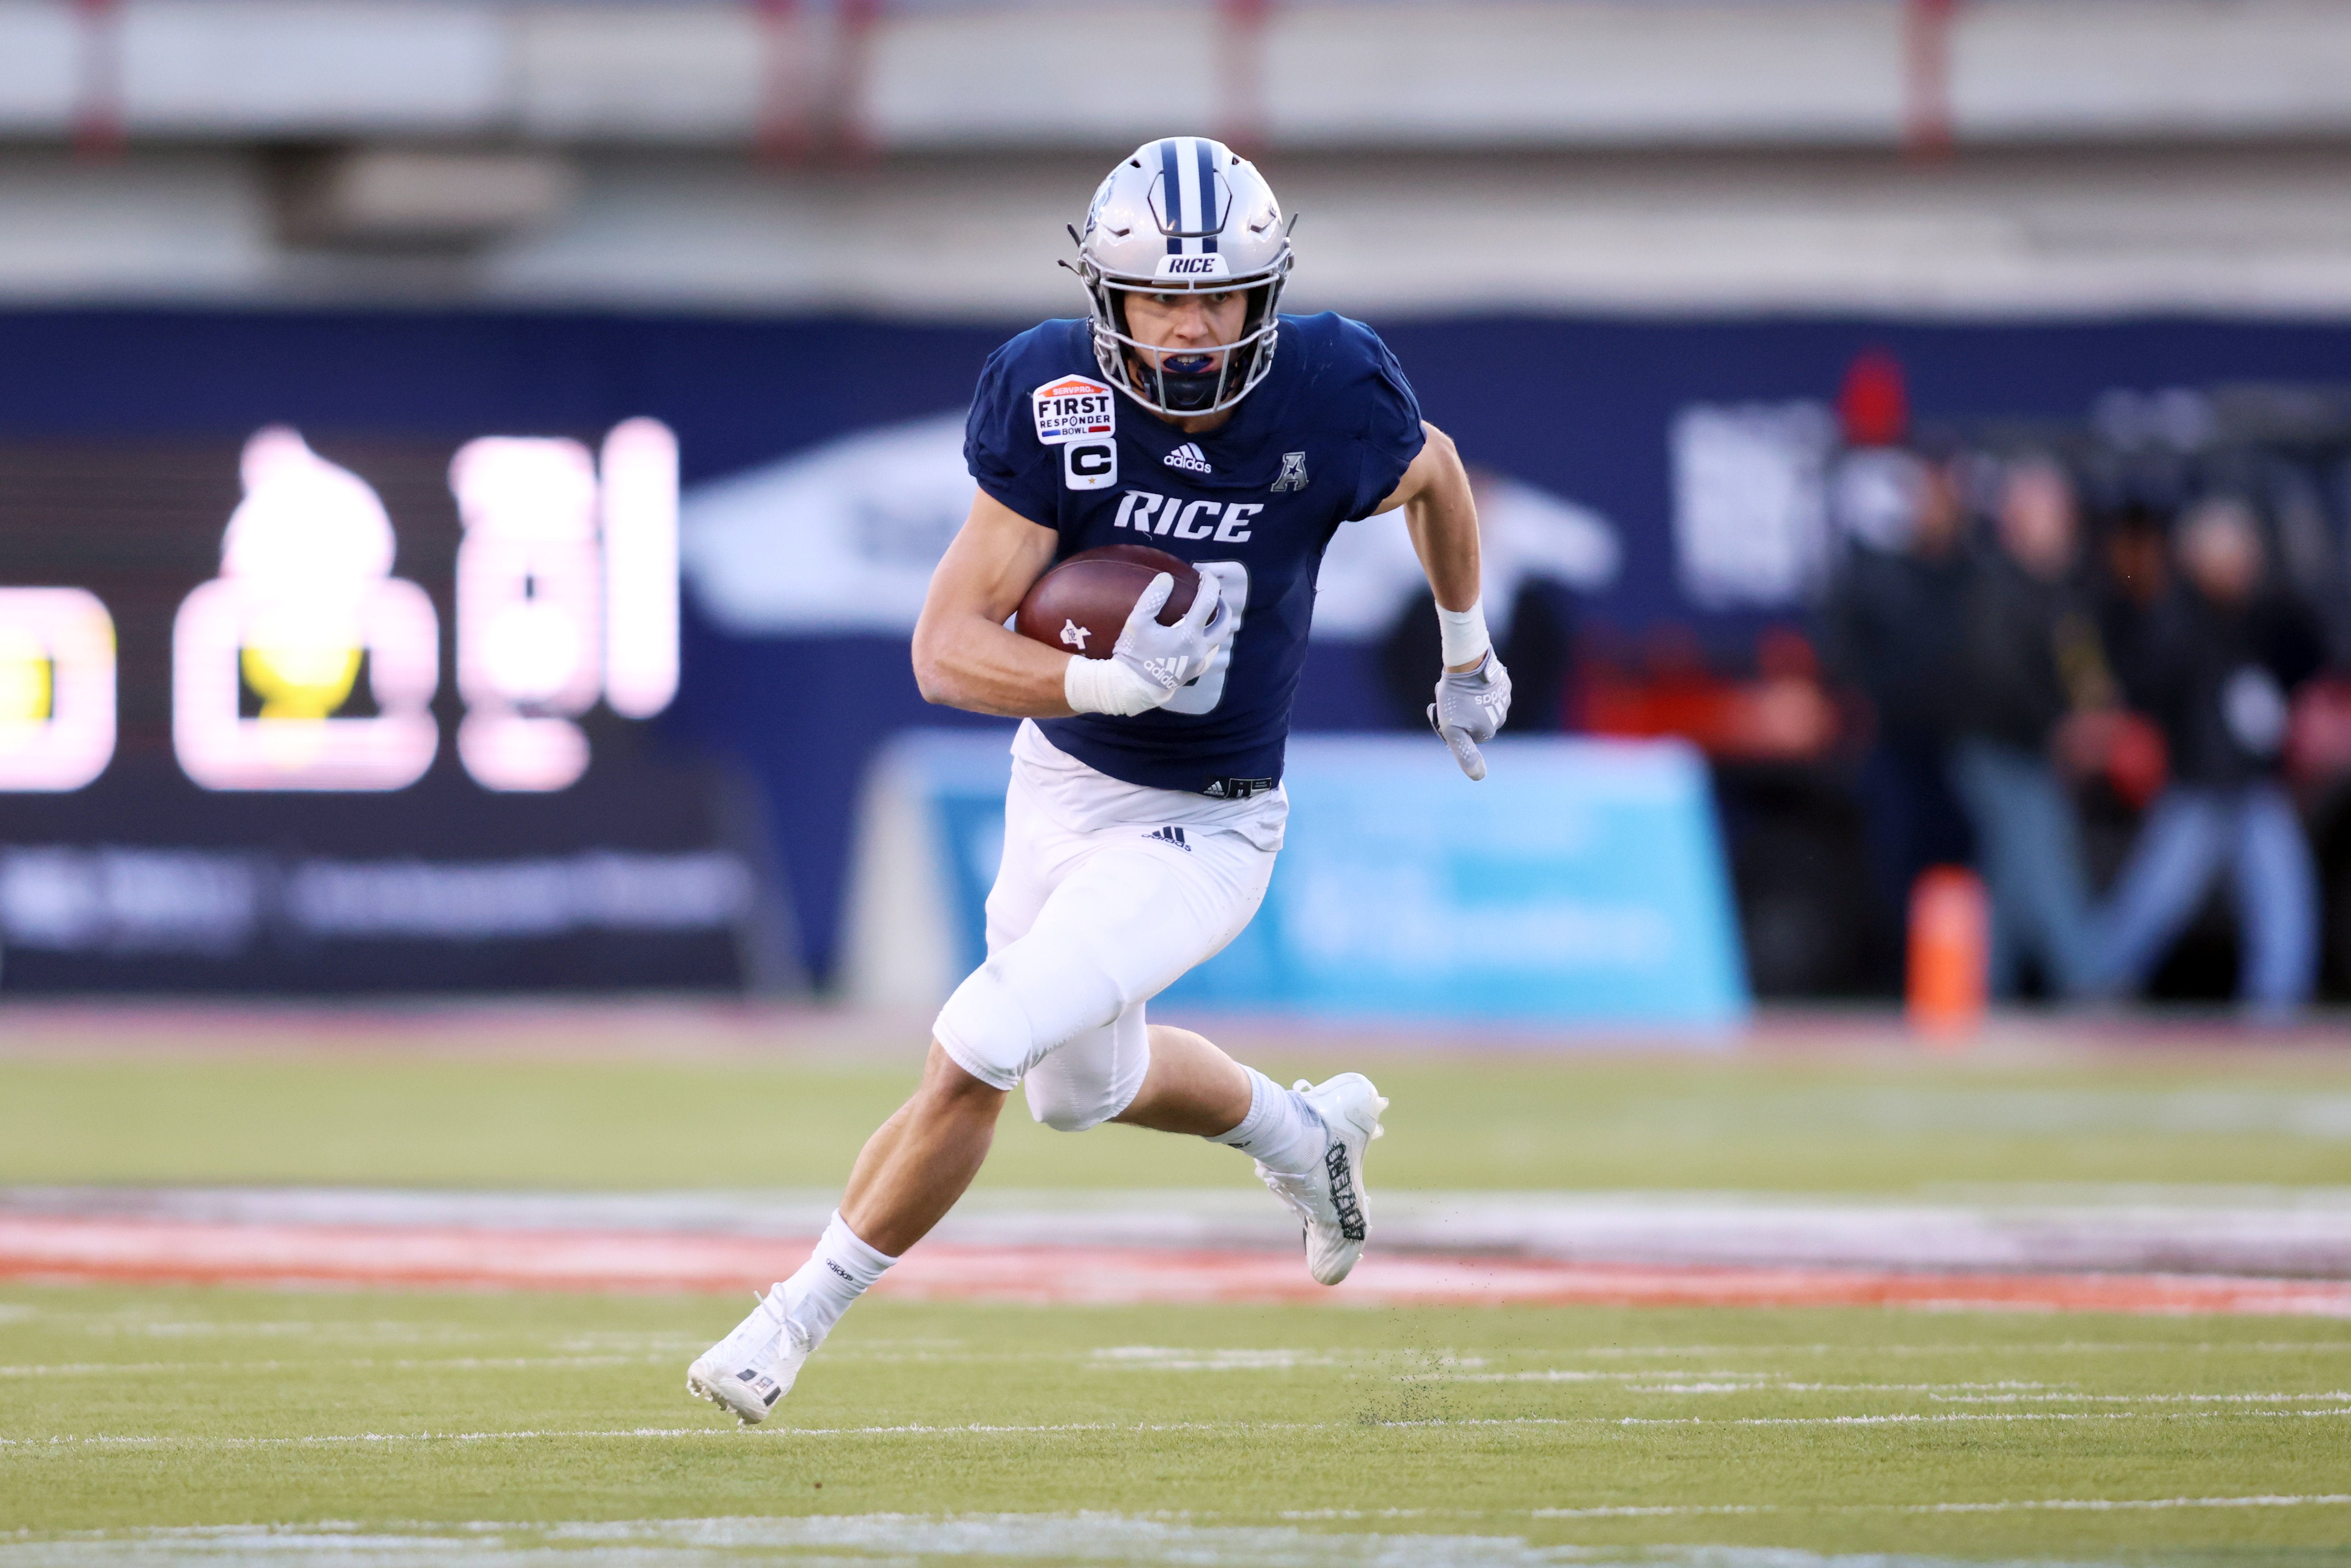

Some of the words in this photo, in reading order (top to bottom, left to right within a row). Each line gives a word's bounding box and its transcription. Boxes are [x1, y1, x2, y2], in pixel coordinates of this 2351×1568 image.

[1168, 258, 1215, 273] RICE
[1053, 386, 1090, 395] SERVPRO
[1039, 396, 1109, 418] F1RST
[1040, 415, 1110, 428] RESPONDER
[1071, 445, 1111, 476] C
[1164, 451, 1212, 474] adidas
[1114, 490, 1264, 543] RICE
[1141, 834, 1191, 852] adidas
[826, 1258, 854, 1281] adidas
